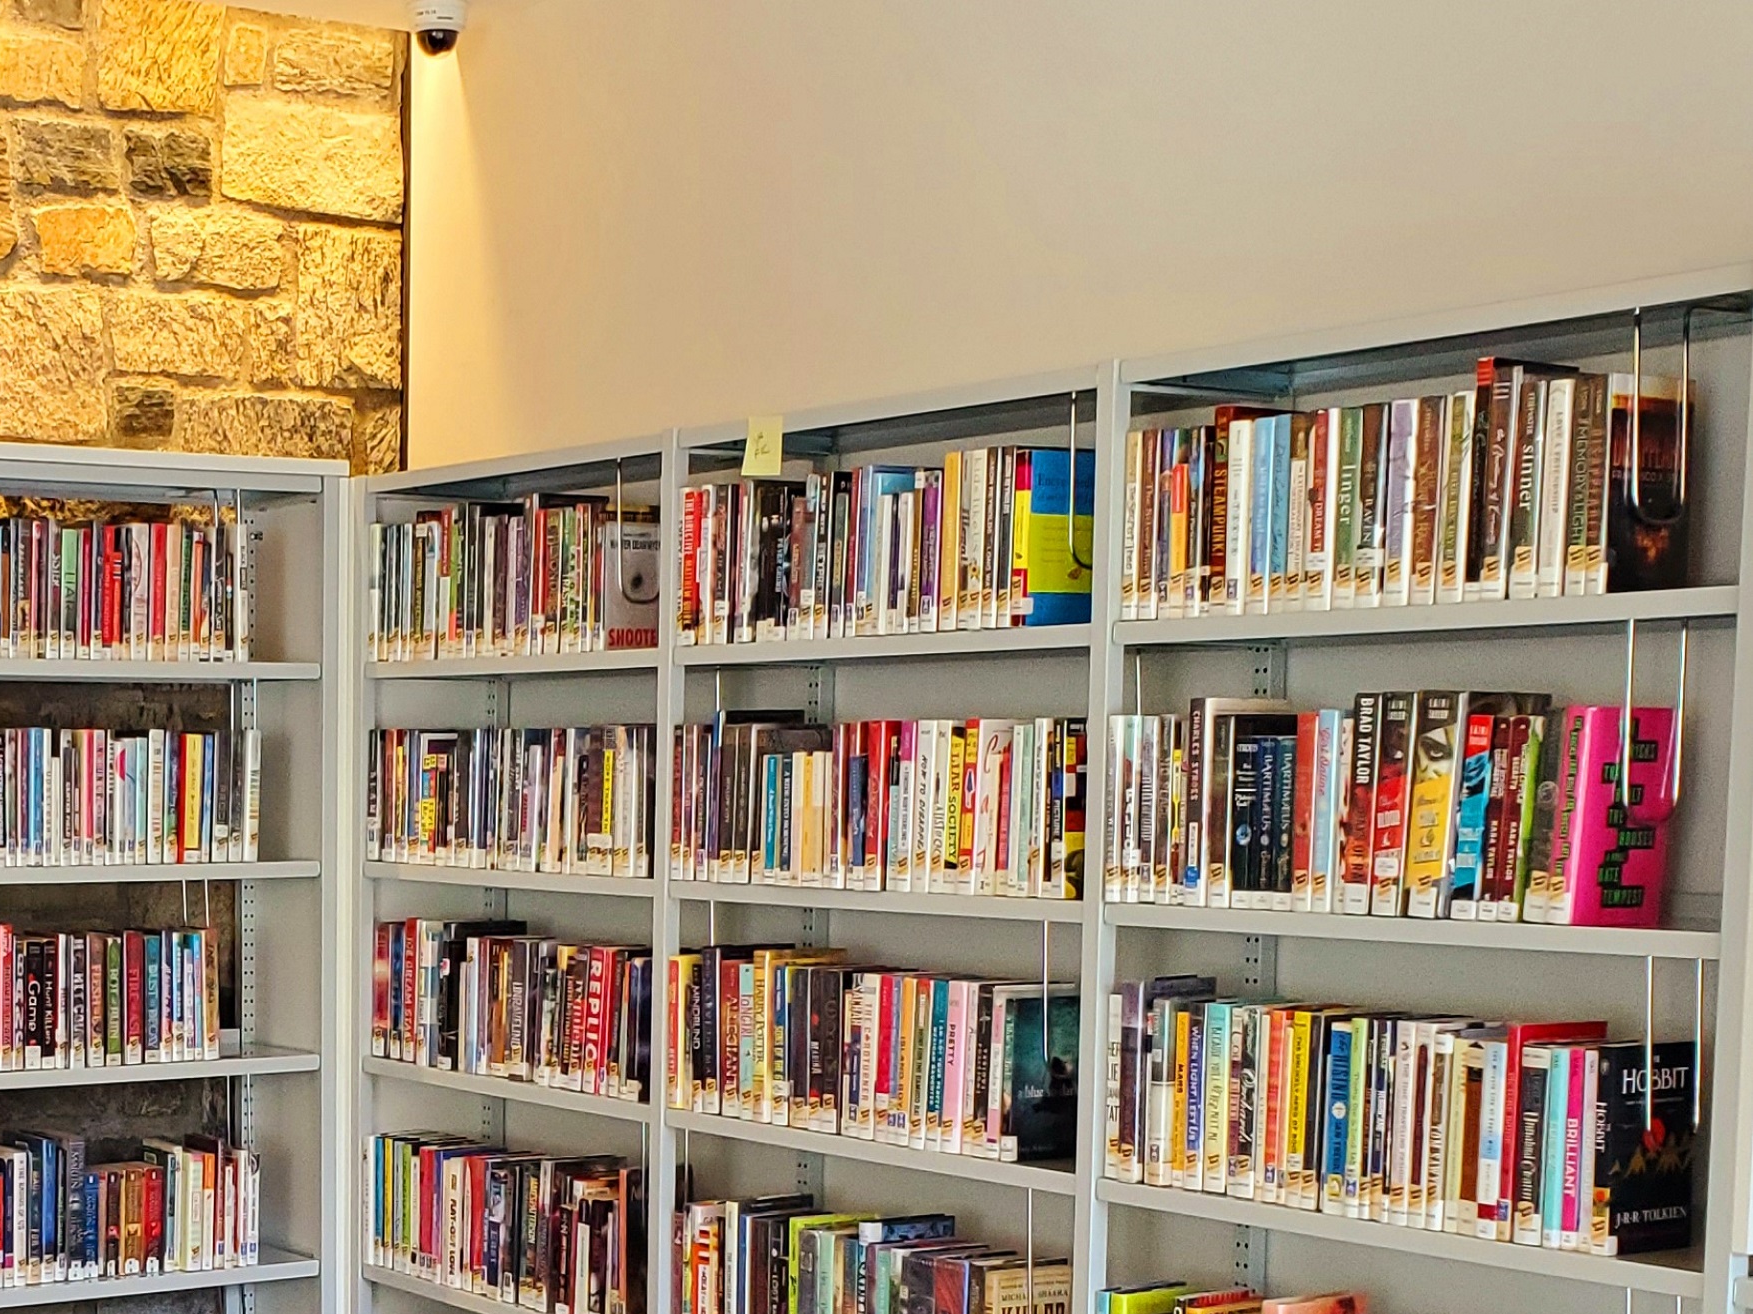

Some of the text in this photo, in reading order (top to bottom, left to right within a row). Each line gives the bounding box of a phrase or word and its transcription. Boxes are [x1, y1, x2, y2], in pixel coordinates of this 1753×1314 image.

[1338, 464, 1358, 525] linger
[1518, 444, 1535, 512] sinner
[608, 628, 657, 647] SHOOTE
[1356, 697, 1374, 784] BRAD TAYLOR
[947, 751, 961, 859] LIAR SOCIETY
[28, 980, 40, 1031] Game
[129, 969, 139, 997] FIRE
[586, 959, 601, 1060] REPLIC
[1564, 1117, 1579, 1198] BRILLIANT
[1642, 1206, 1687, 1223] TOLKIEN
